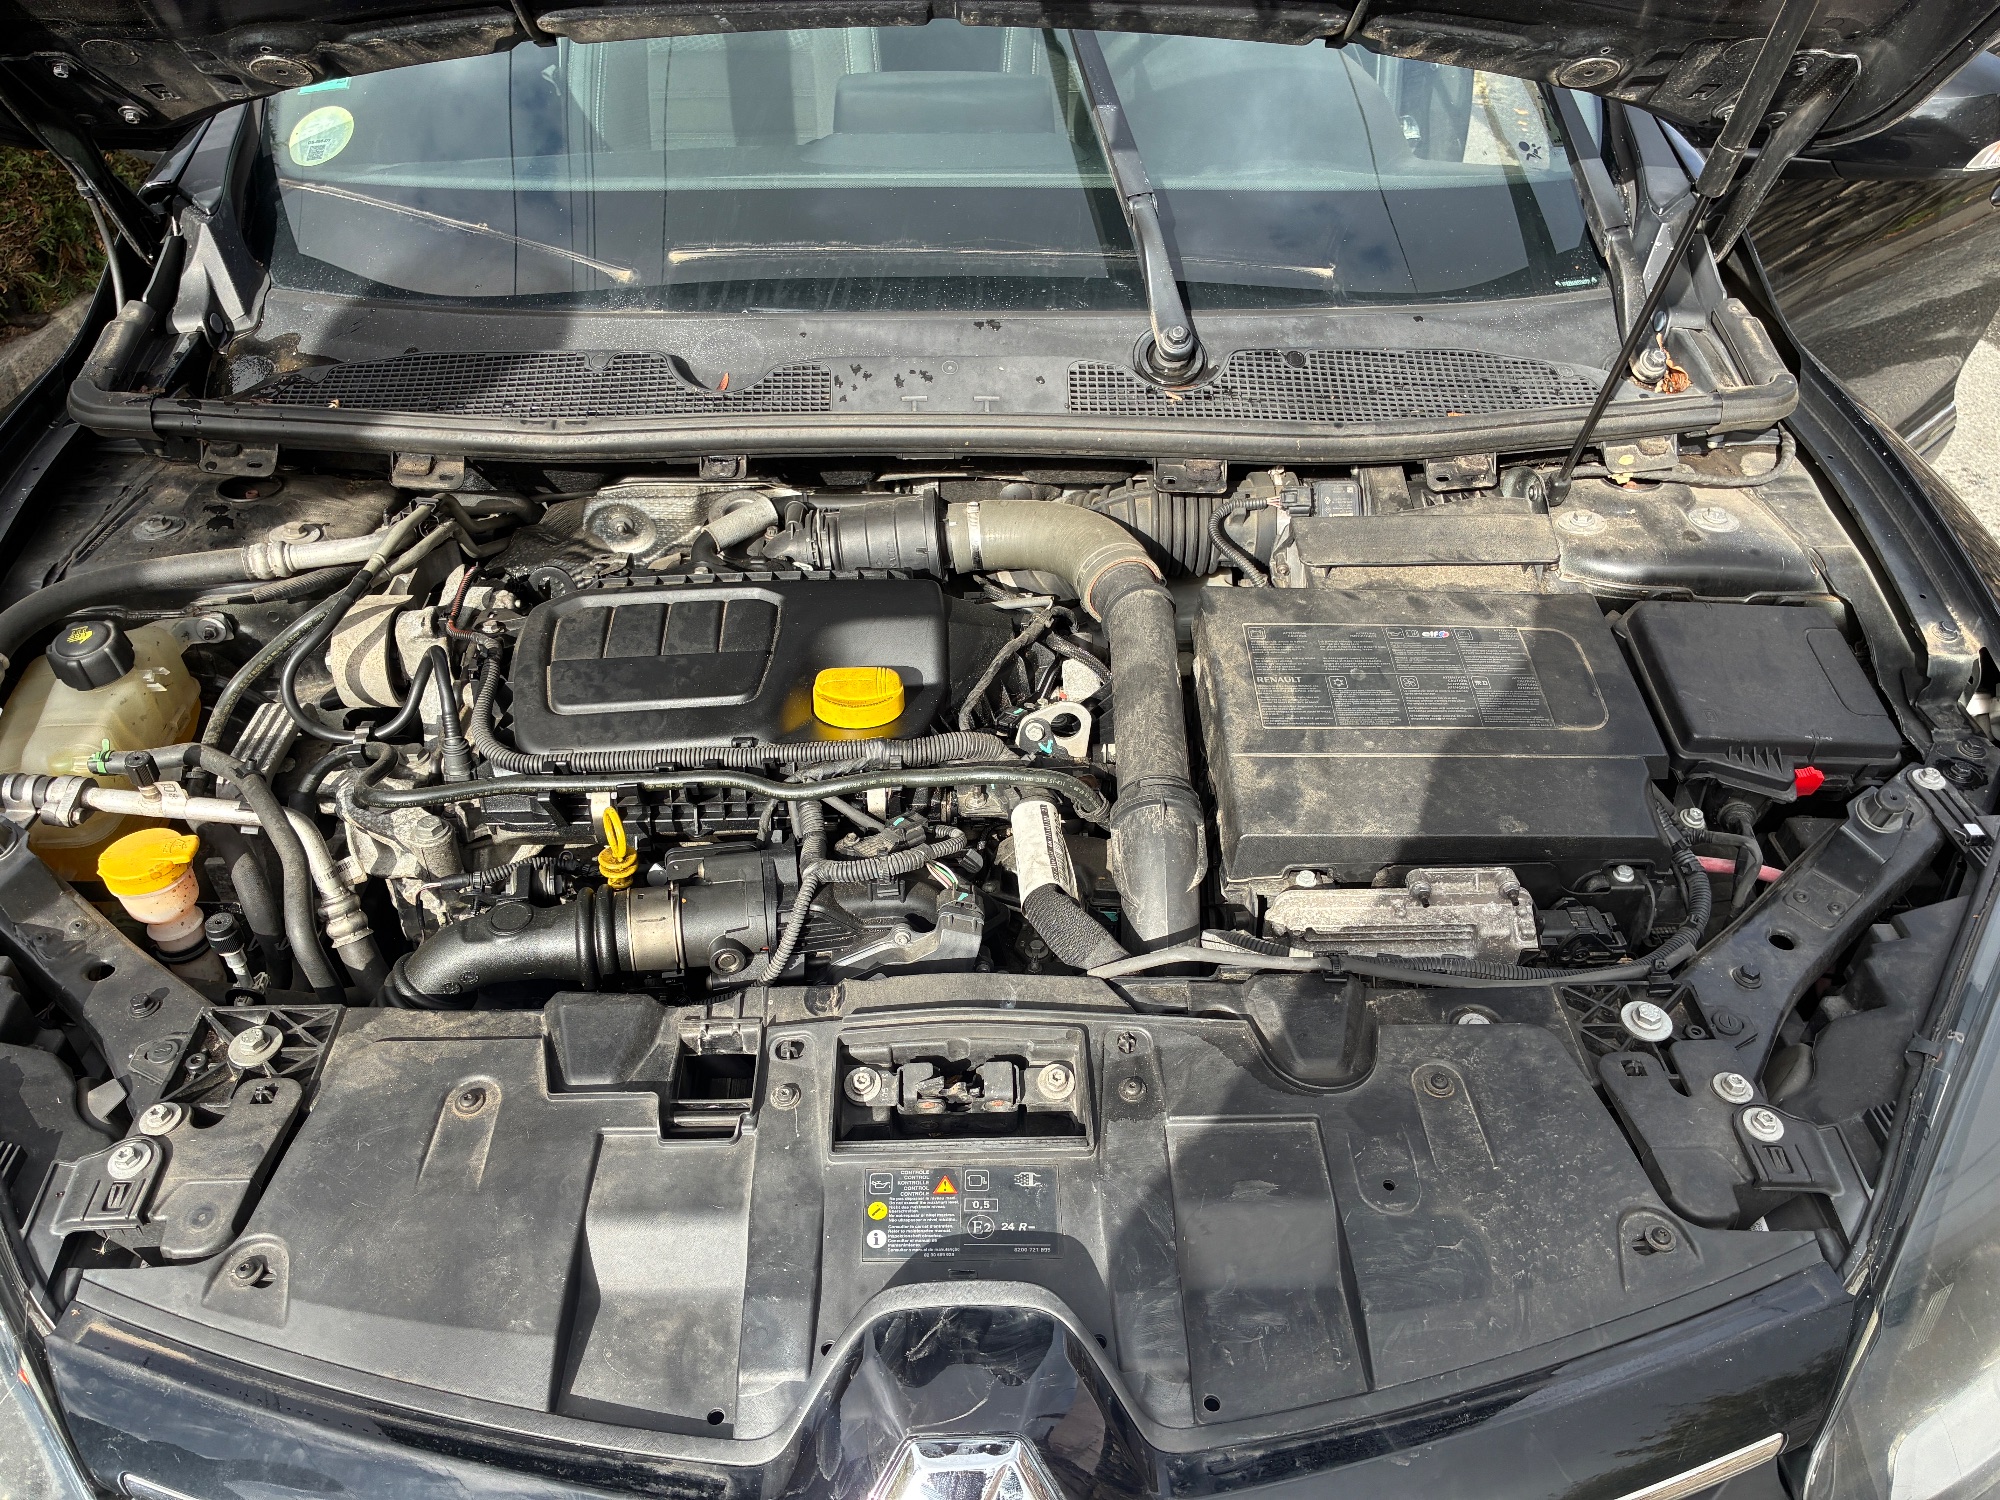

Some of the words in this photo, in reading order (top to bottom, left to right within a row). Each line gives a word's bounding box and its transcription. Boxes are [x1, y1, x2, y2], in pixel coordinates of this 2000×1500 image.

[972, 1200, 990, 1210] 0,5
[972, 1220, 993, 1235] E2
[1001, 1222, 1015, 1232] 24
